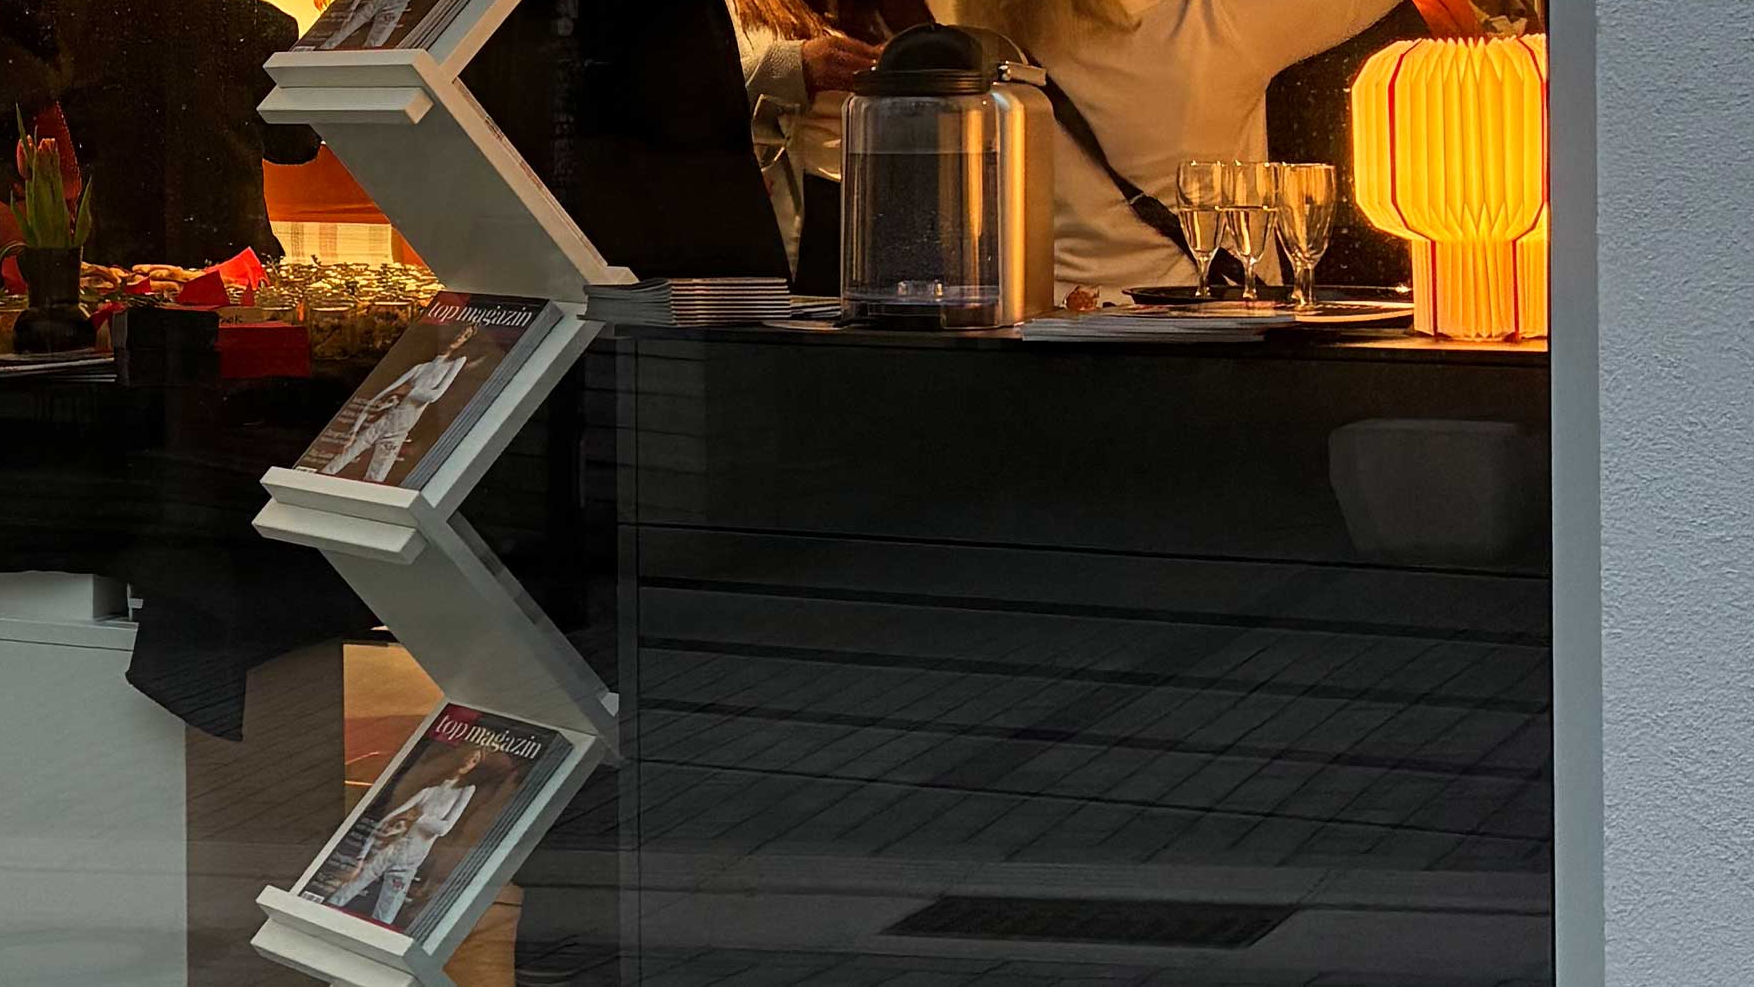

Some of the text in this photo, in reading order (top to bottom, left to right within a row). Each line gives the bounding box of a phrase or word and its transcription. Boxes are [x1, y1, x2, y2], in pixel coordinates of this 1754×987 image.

[427, 300, 534, 328] top magazin
[434, 714, 543, 761] top magazin
